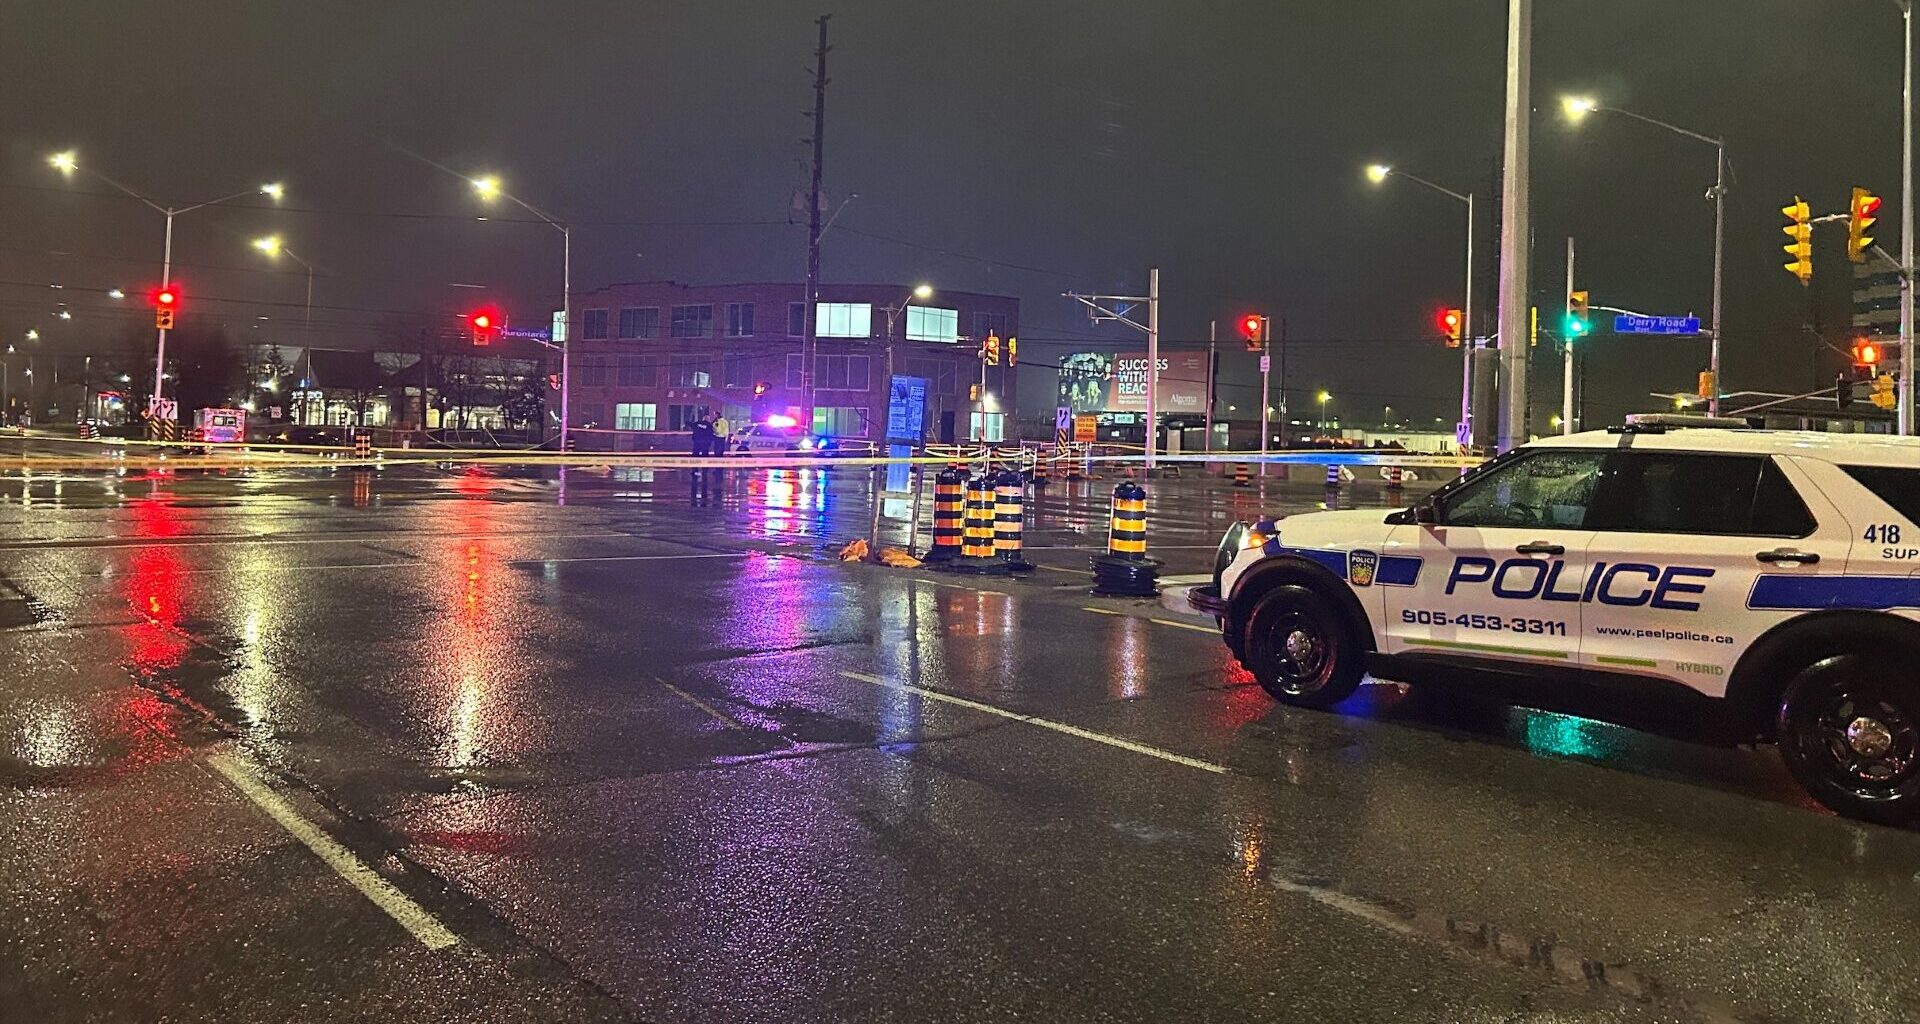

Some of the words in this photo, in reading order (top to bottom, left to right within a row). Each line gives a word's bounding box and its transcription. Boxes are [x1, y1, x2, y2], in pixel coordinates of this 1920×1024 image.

[1628, 317, 1657, 328] Derry
[1659, 317, 1686, 327] Road
[501, 328, 548, 338] Hurontario
[1118, 359, 1169, 371] SUCCSS
[1118, 371, 1159, 382] WITH
[1118, 383, 1148, 394] REAC
[1171, 394, 1198, 404] Algoma
[1863, 523, 1901, 544] 418
[1882, 547, 1919, 559] SUP
[1351, 556, 1375, 564] POLICE
[1445, 556, 1716, 611] POLICE
[1402, 609, 1566, 636] 905-453-3311
[1596, 626, 1734, 645] www.peelpolice.ca
[1675, 662, 1724, 676] HYBRID
